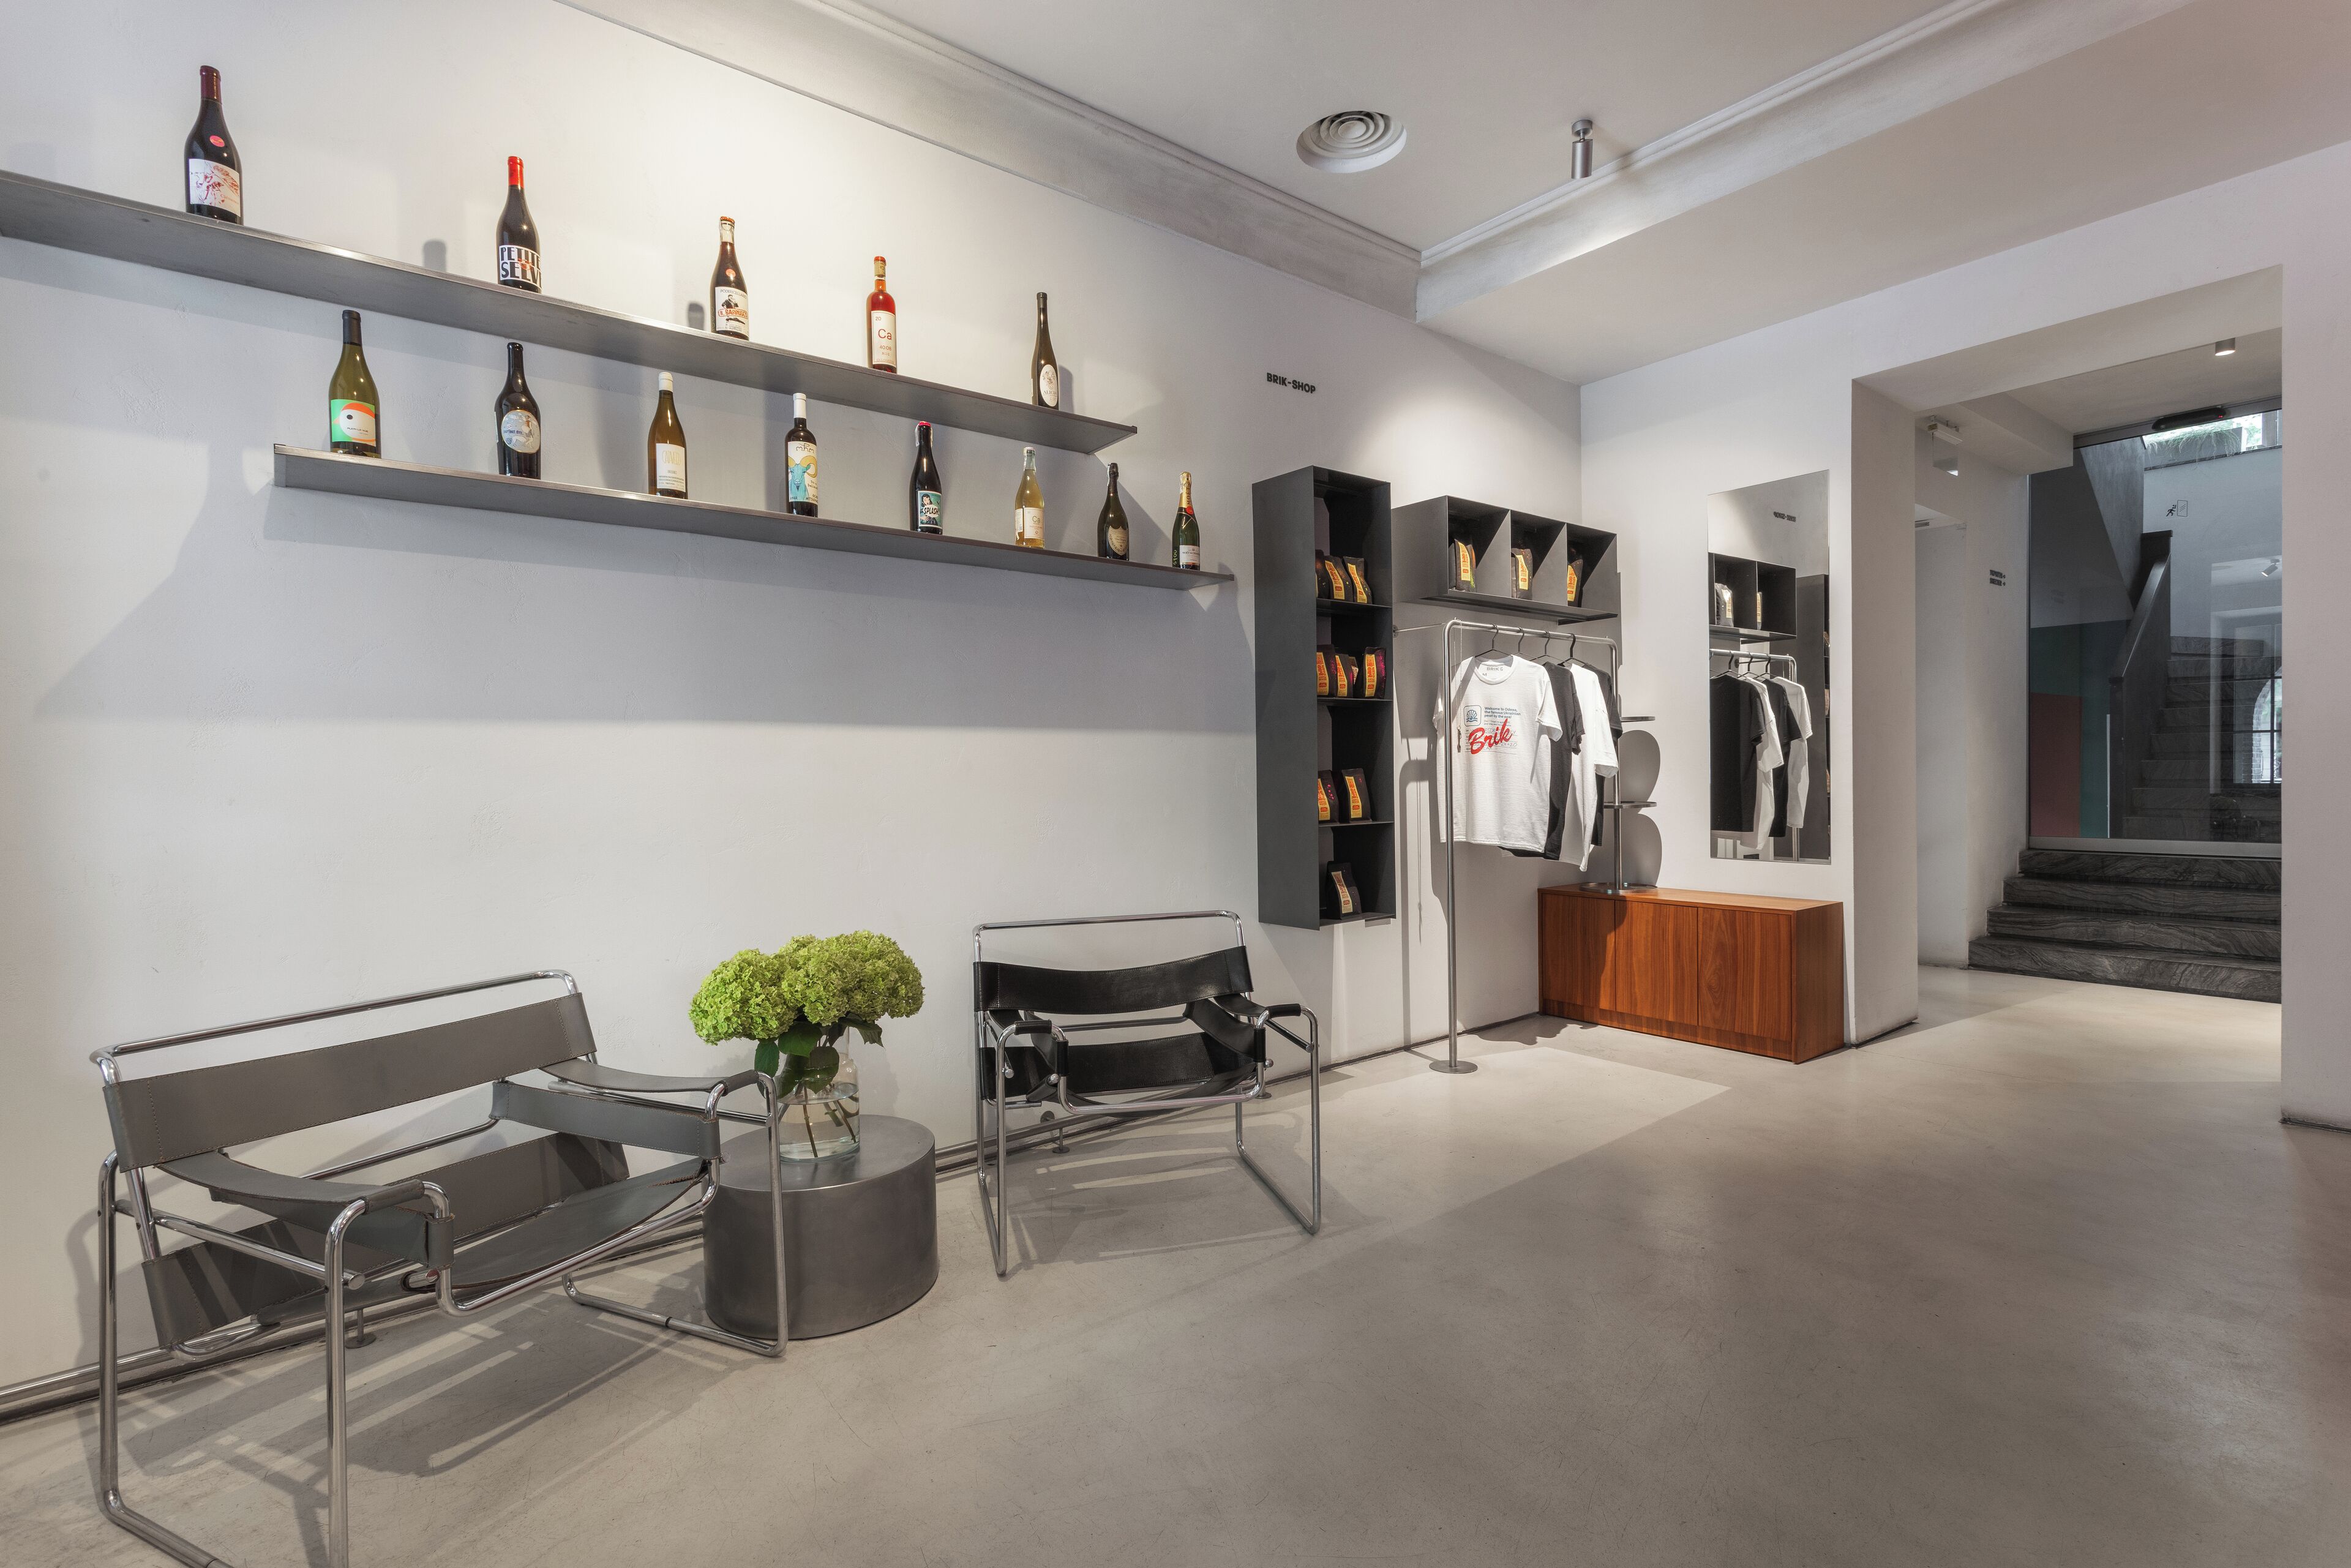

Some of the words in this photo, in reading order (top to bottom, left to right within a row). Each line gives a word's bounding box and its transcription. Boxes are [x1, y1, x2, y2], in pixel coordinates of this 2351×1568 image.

[878, 328, 892, 340] Ca
[1267, 372, 1316, 393] BRIK-SHOP
[1468, 718, 1513, 754] Brik
